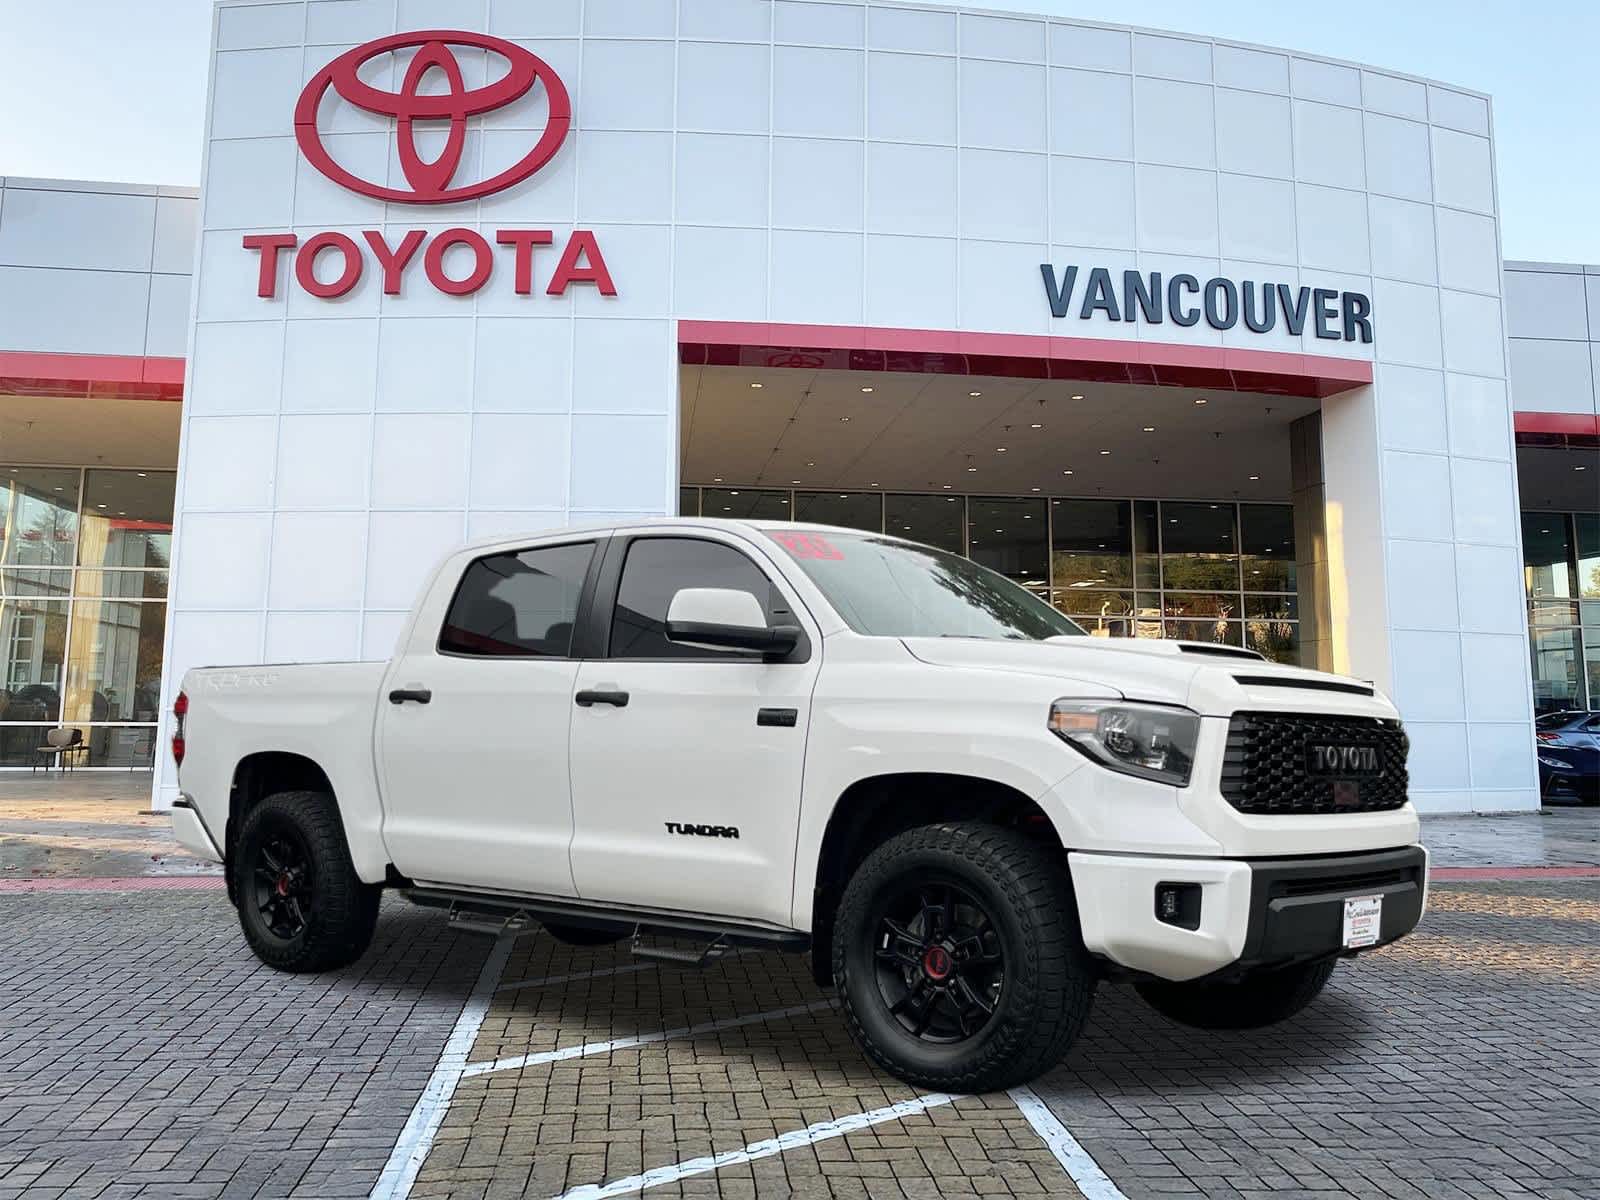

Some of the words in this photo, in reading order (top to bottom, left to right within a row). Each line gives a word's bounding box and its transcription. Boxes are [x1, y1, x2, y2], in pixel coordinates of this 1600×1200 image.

[243, 228, 618, 299] TOYOTA
[1040, 264, 1373, 344] VANCOUVER
[1312, 745, 1379, 770] TOYOTA
[664, 822, 740, 839] TUNDRA
